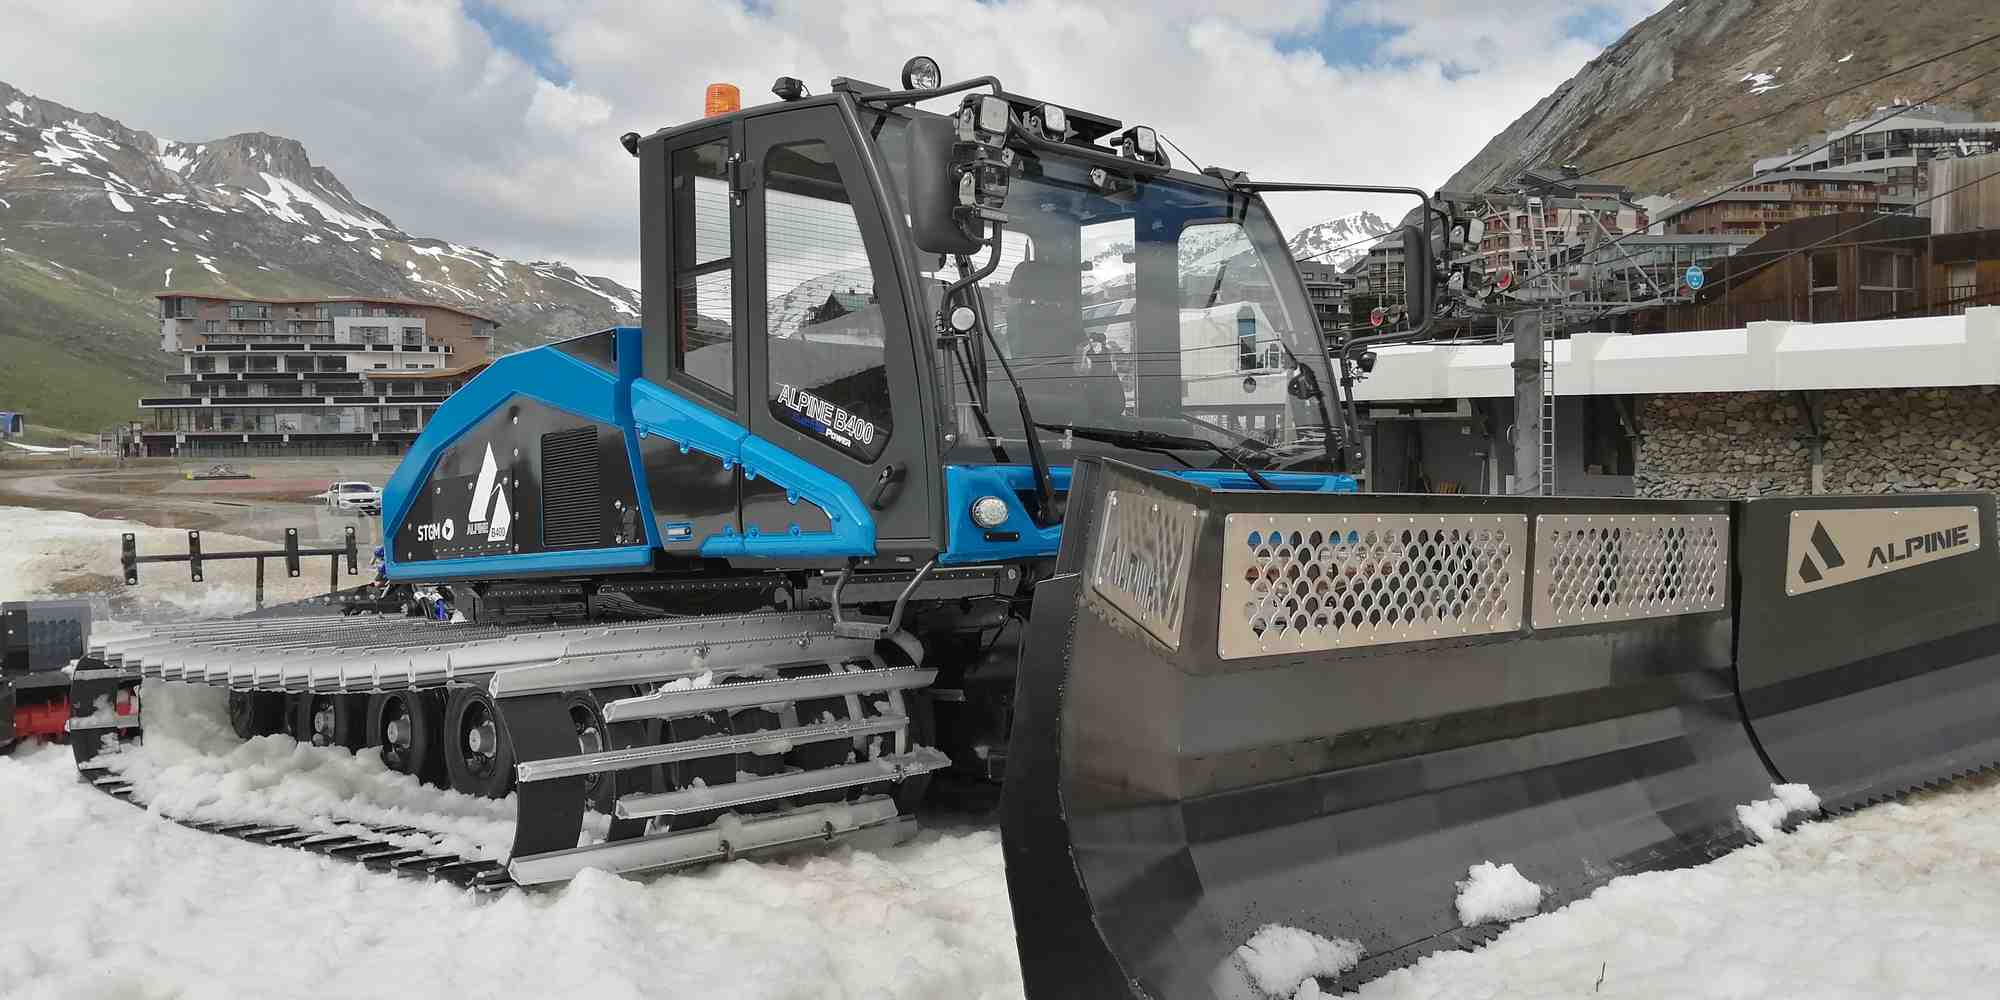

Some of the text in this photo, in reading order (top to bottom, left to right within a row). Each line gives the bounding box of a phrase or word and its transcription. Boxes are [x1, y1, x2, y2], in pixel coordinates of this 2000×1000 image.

[777, 384, 834, 426] ALPINE
[833, 408, 874, 444] B400
[417, 523, 441, 542] STGM
[1867, 524, 1969, 569] ALPINE
